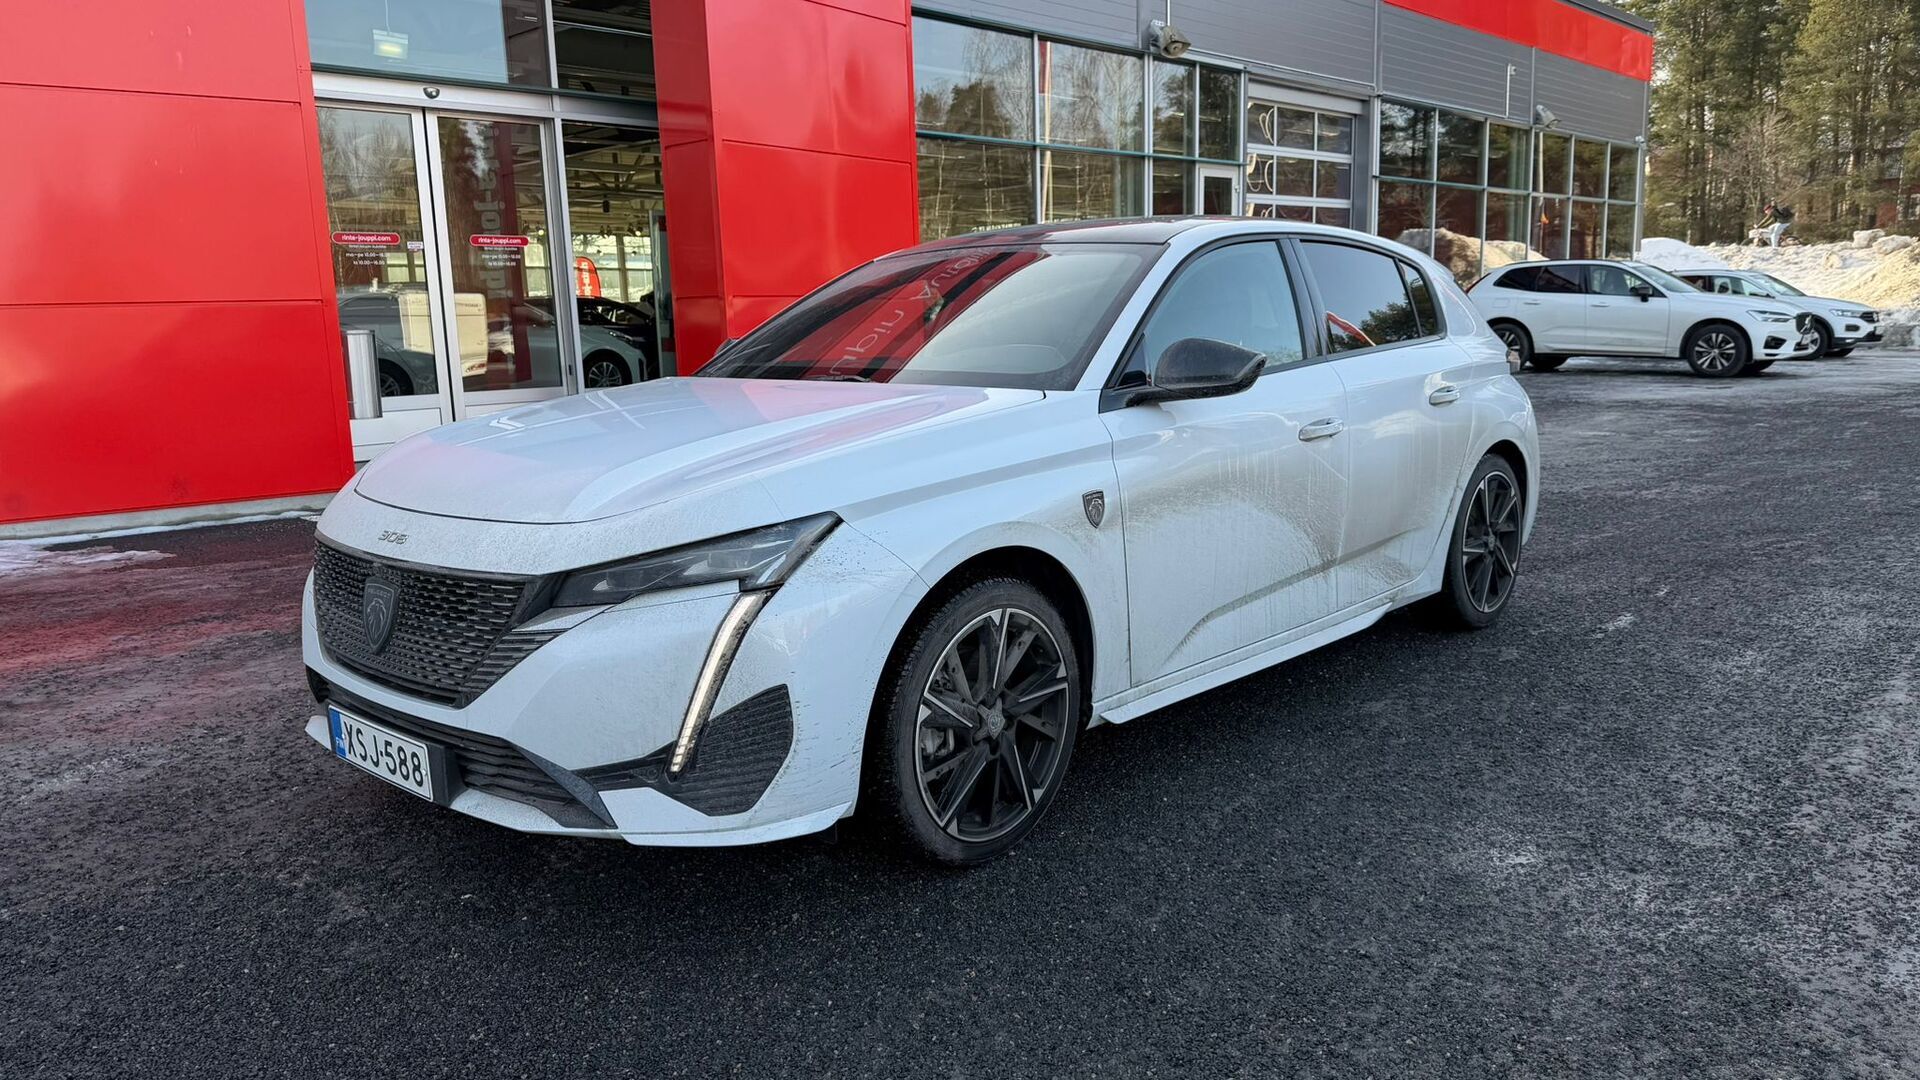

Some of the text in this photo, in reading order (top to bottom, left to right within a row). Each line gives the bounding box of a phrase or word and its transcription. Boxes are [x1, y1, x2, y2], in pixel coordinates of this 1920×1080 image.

[341, 233, 391, 242] rinta-jouppi.com
[478, 236, 522, 245] rinta-jouppi.com
[378, 530, 407, 545] 308
[343, 720, 424, 788] XSJ-588
